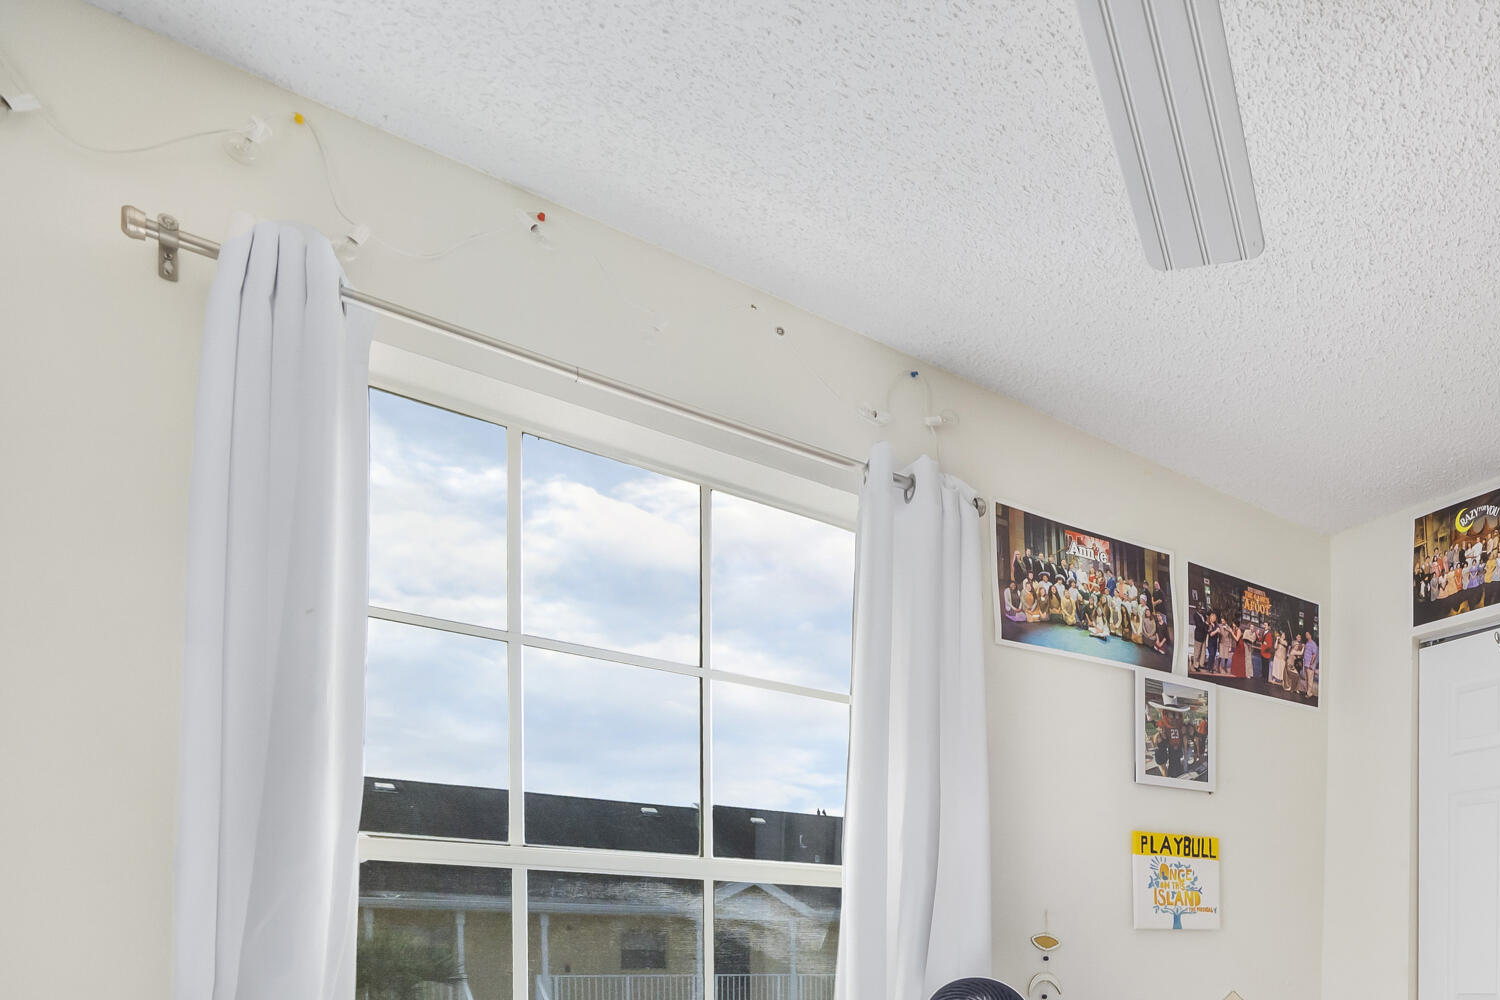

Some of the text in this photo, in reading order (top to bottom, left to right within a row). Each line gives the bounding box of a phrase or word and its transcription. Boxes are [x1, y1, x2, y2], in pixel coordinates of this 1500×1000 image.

[1486, 504, 1500, 517] YOU
[1140, 835, 1217, 859] PLAYBULL
[1159, 863, 1193, 881] ONCE
[1153, 887, 1201, 907] ISLAND
